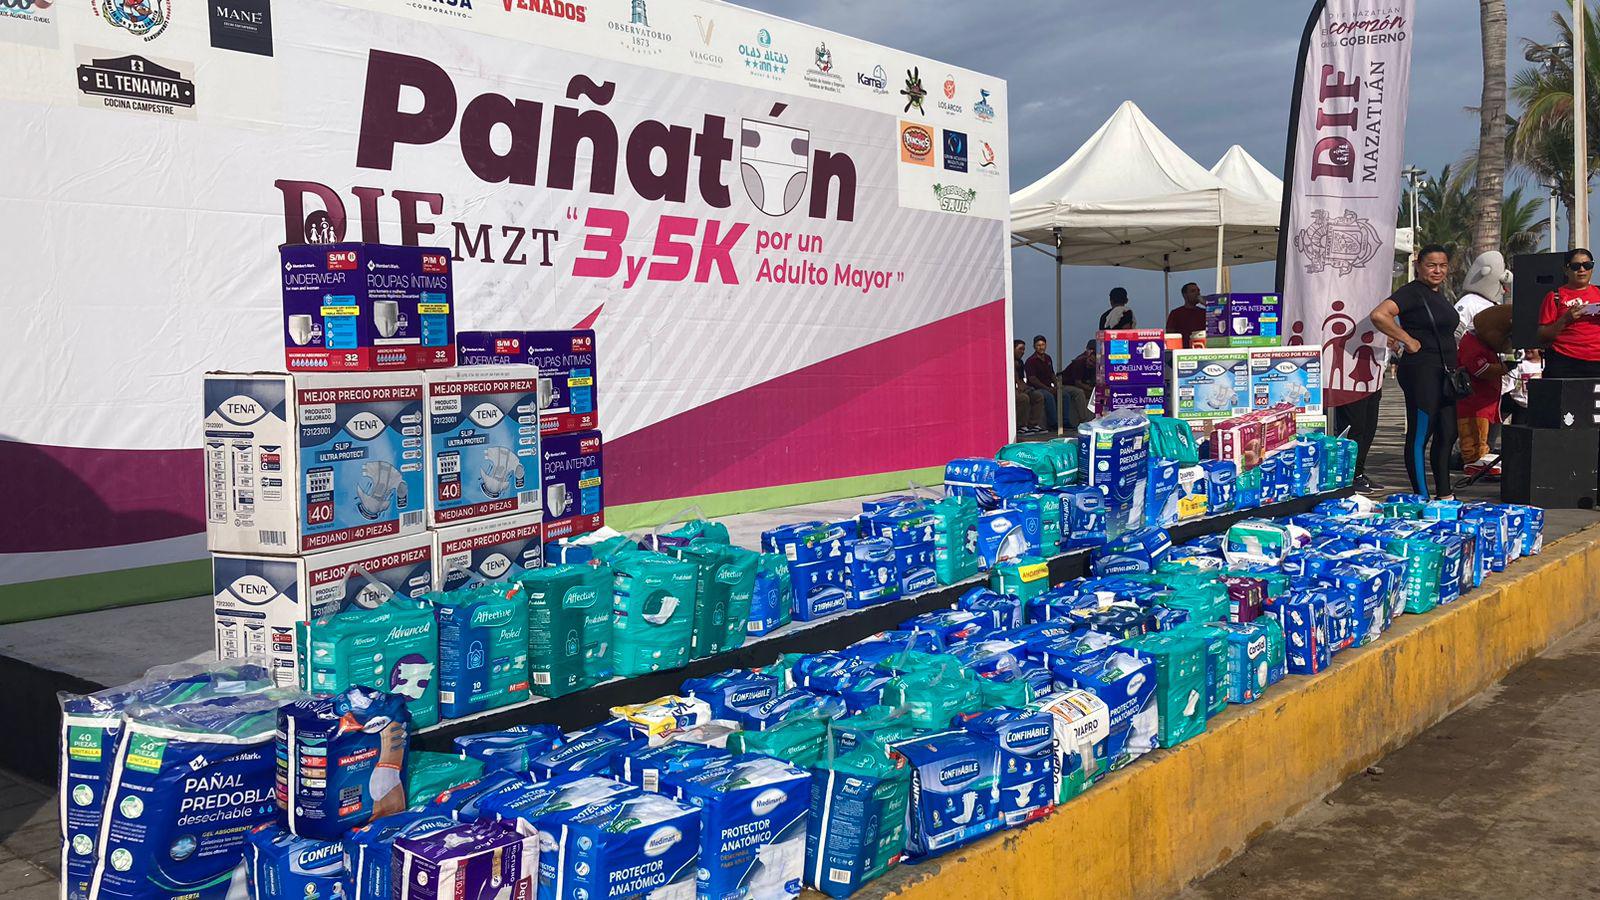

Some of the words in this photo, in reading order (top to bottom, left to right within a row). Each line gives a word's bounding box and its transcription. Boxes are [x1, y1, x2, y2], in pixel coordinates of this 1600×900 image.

[411, 3, 467, 18] CORPORATIVO
[608, 21, 672, 42] OBSERVATORIO
[1329, 14, 1407, 36] corazón
[632, 37, 650, 47] 1873
[1340, 31, 1407, 47] GOBIERNO
[690, 50, 724, 65] VIAGGIO
[96, 72, 113, 89] EL
[115, 75, 180, 99] TENAMPA
[857, 72, 882, 89] Kama
[104, 98, 131, 110] COCINA
[132, 101, 174, 115] CAMPESTRE
[1311, 63, 1361, 183] DIF
[1362, 61, 1386, 183] MAZATLÁN
[451, 222, 559, 267] MZT
[756, 229, 792, 255] por
[798, 234, 823, 254] un
[423, 256, 437, 265] P/M
[285, 272, 346, 286] UNDERWEAR
[756, 258, 828, 286] Adulto
[368, 274, 410, 289] ROUPAS
[411, 274, 448, 290] ÍNTIMAS
[345, 354, 359, 362] 32
[436, 350, 446, 358] 32
[562, 354, 592, 366] ÍNTIMAS
[434, 383, 462, 394] MEJOR
[464, 382, 492, 392] PRECIO
[494, 382, 509, 391] POR
[304, 391, 336, 403] MEJOR
[338, 390, 371, 401] PRECIO
[374, 390, 391, 399] POR
[227, 403, 256, 414] TENA
[476, 409, 498, 420] TENA
[304, 414, 332, 422] MEJORADO
[354, 420, 379, 430] TENA
[302, 428, 331, 436] 73123001
[335, 443, 349, 451] SLIP
[448, 438, 464, 447] ULTRA
[464, 436, 486, 445] PROTECT
[320, 453, 339, 462] ULTRA
[339, 451, 364, 460] PROTECT
[544, 461, 565, 474] ROPA
[566, 455, 596, 470] INTERIOR
[442, 484, 458, 498] 40
[311, 505, 331, 521] 40
[440, 508, 474, 520] MEDIANO
[480, 504, 488, 513] 40
[490, 500, 512, 511] PIEZAS
[308, 532, 348, 546] MEDIANO
[354, 530, 365, 539] 40
[366, 524, 393, 537] PIEZAS
[446, 540, 475, 552] MEJOR
[476, 534, 505, 547] PRECIO
[506, 532, 521, 541] POR
[315, 570, 346, 583] MEJOR
[382, 556, 399, 568] POR
[486, 559, 508, 572] TENA
[718, 568, 744, 581] Affective
[239, 584, 269, 595] TENA
[566, 591, 596, 604] Affective
[474, 607, 512, 624] Affective
[384, 622, 431, 644] Advanced
[473, 682, 481, 690] 10
[74, 740, 98, 748] PIEZAS
[78, 734, 92, 742] 40
[134, 748, 159, 758] PIEZAS
[140, 742, 155, 751] 40
[184, 772, 245, 794] PAÑAL
[177, 806, 253, 827] desechable
[722, 819, 771, 840] PROTECTOR
[720, 831, 772, 853] ANATÓMICO
[299, 841, 344, 865] CONFIH
[610, 860, 664, 883] PROTECTOR
[608, 872, 665, 897] ANATÓMICO
